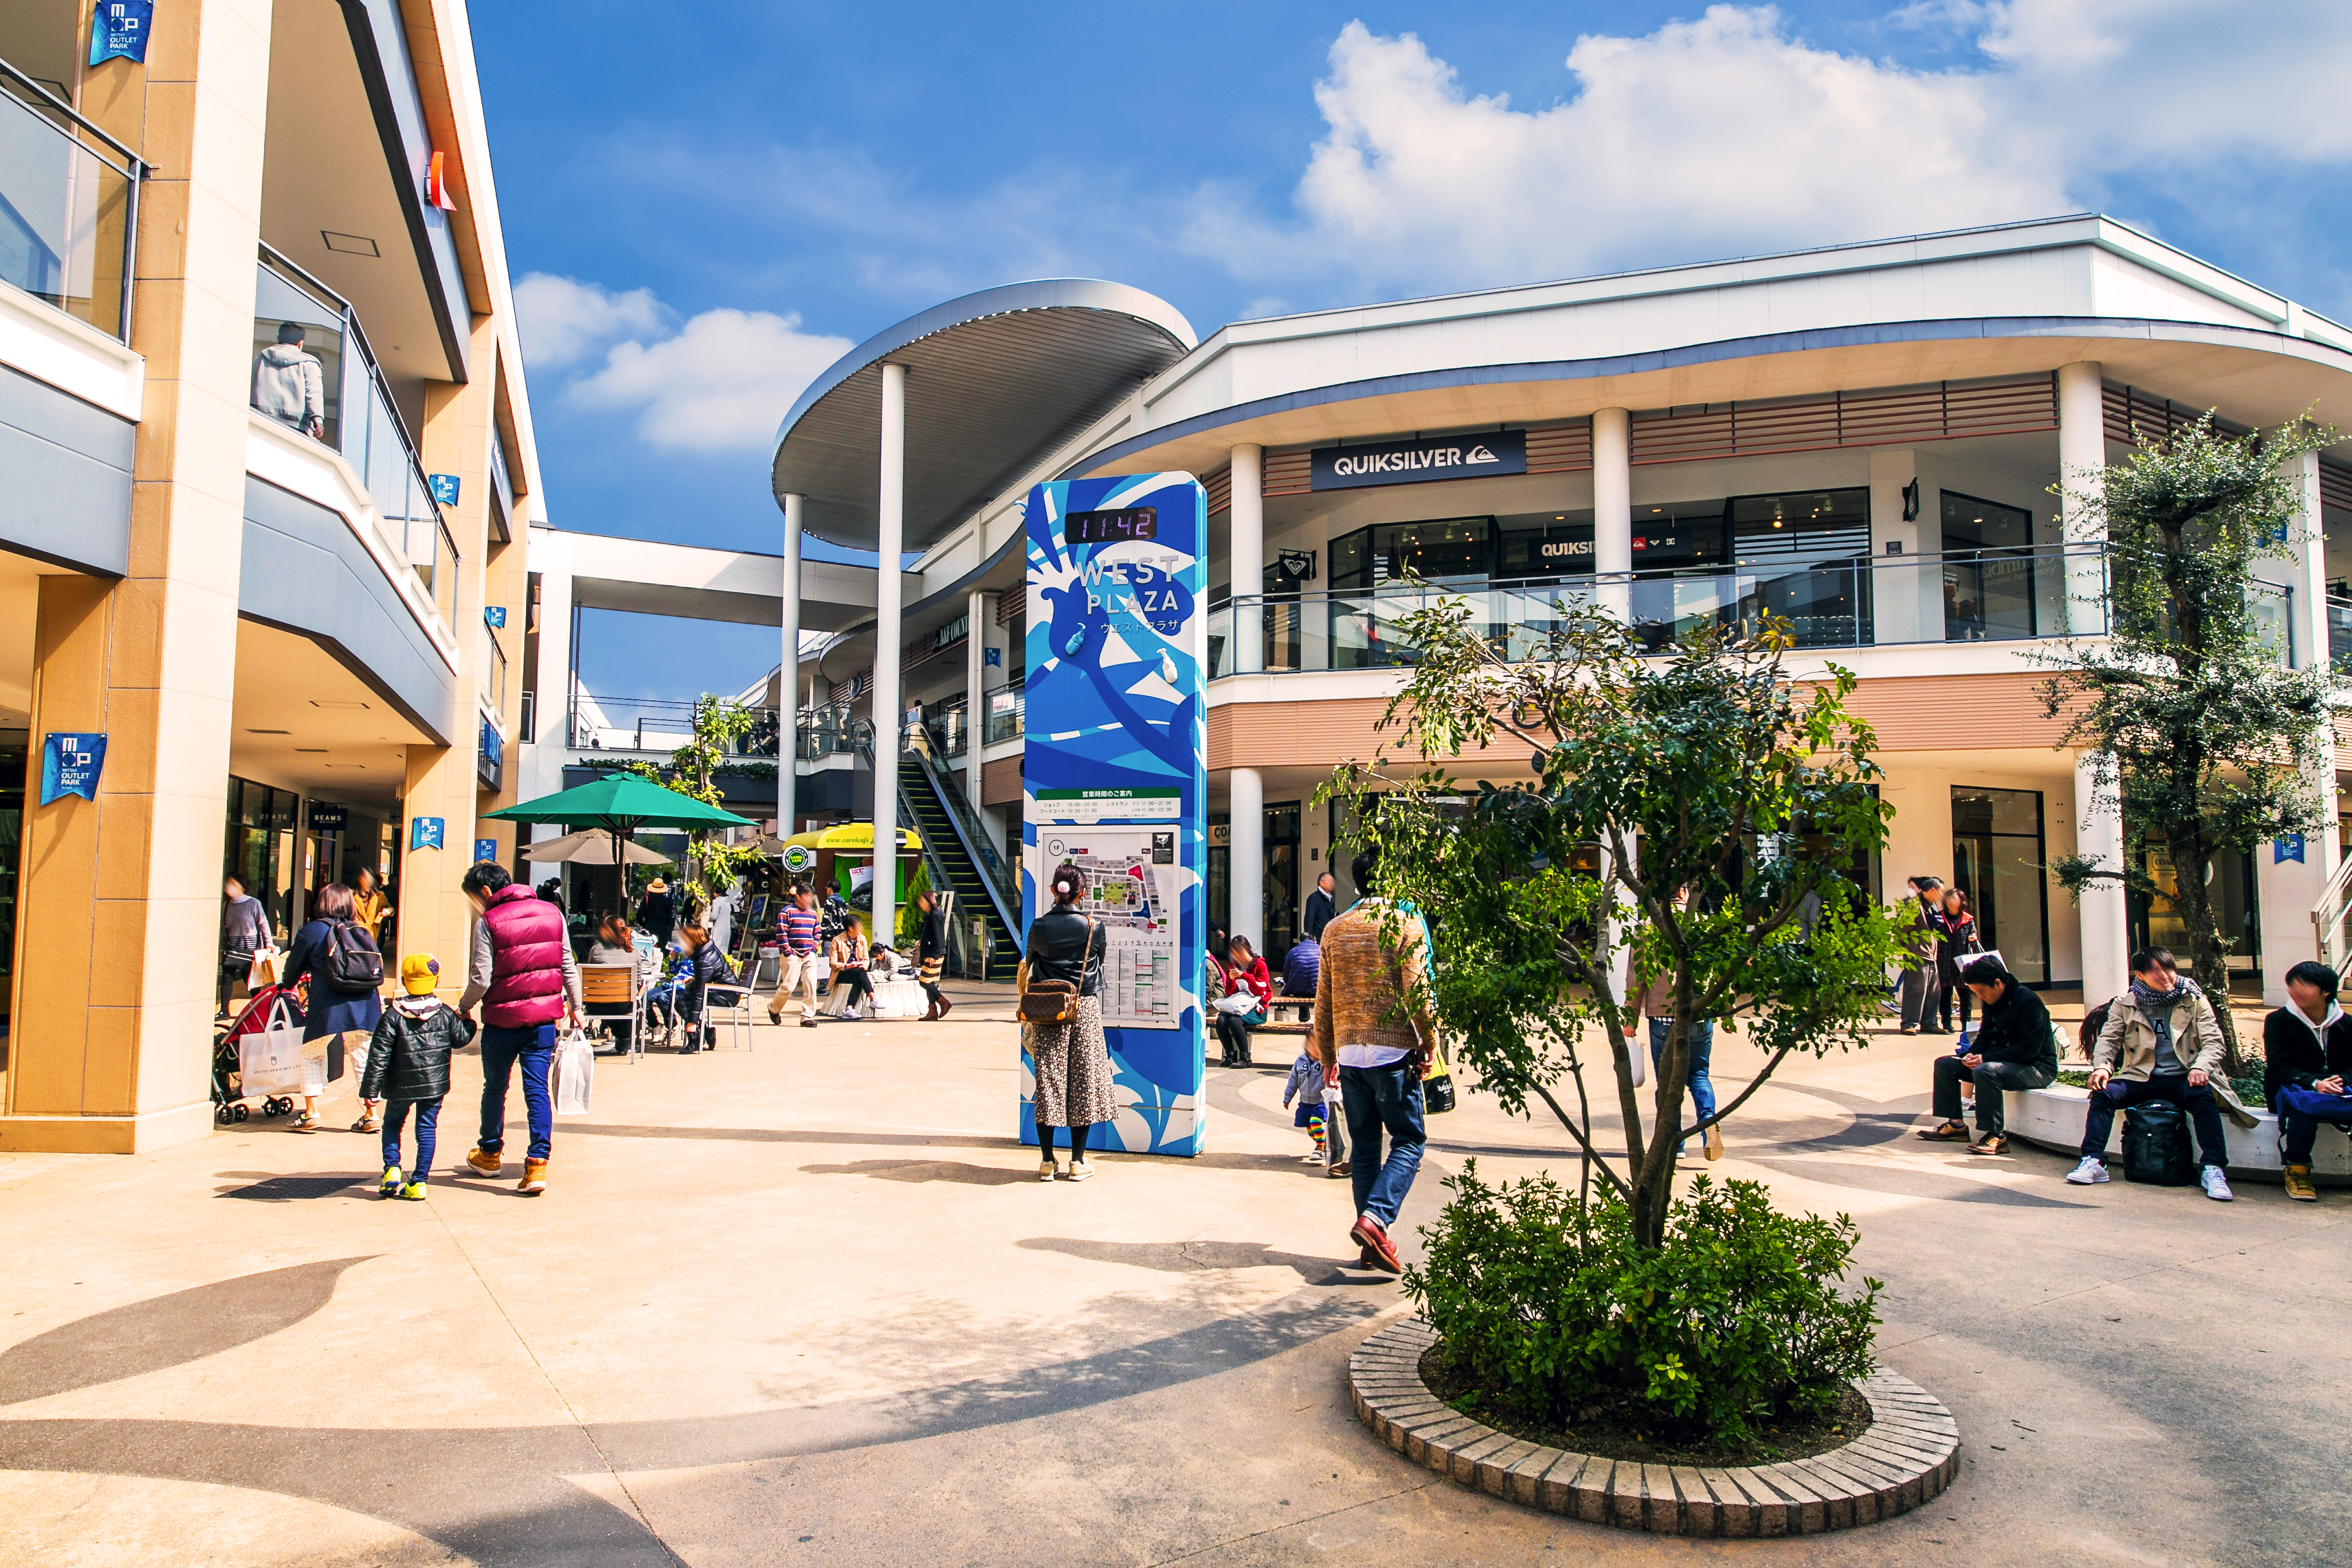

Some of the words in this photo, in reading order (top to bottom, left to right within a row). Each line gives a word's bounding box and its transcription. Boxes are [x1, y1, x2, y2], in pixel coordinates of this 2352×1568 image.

[1334, 448, 1461, 476] QUIKSILVER
[1076, 555, 1179, 587] WEST
[1087, 590, 1178, 615] PLAZA
[951, 614, 969, 641] COUNT
[1100, 619, 1179, 634] ウエストプラザ
